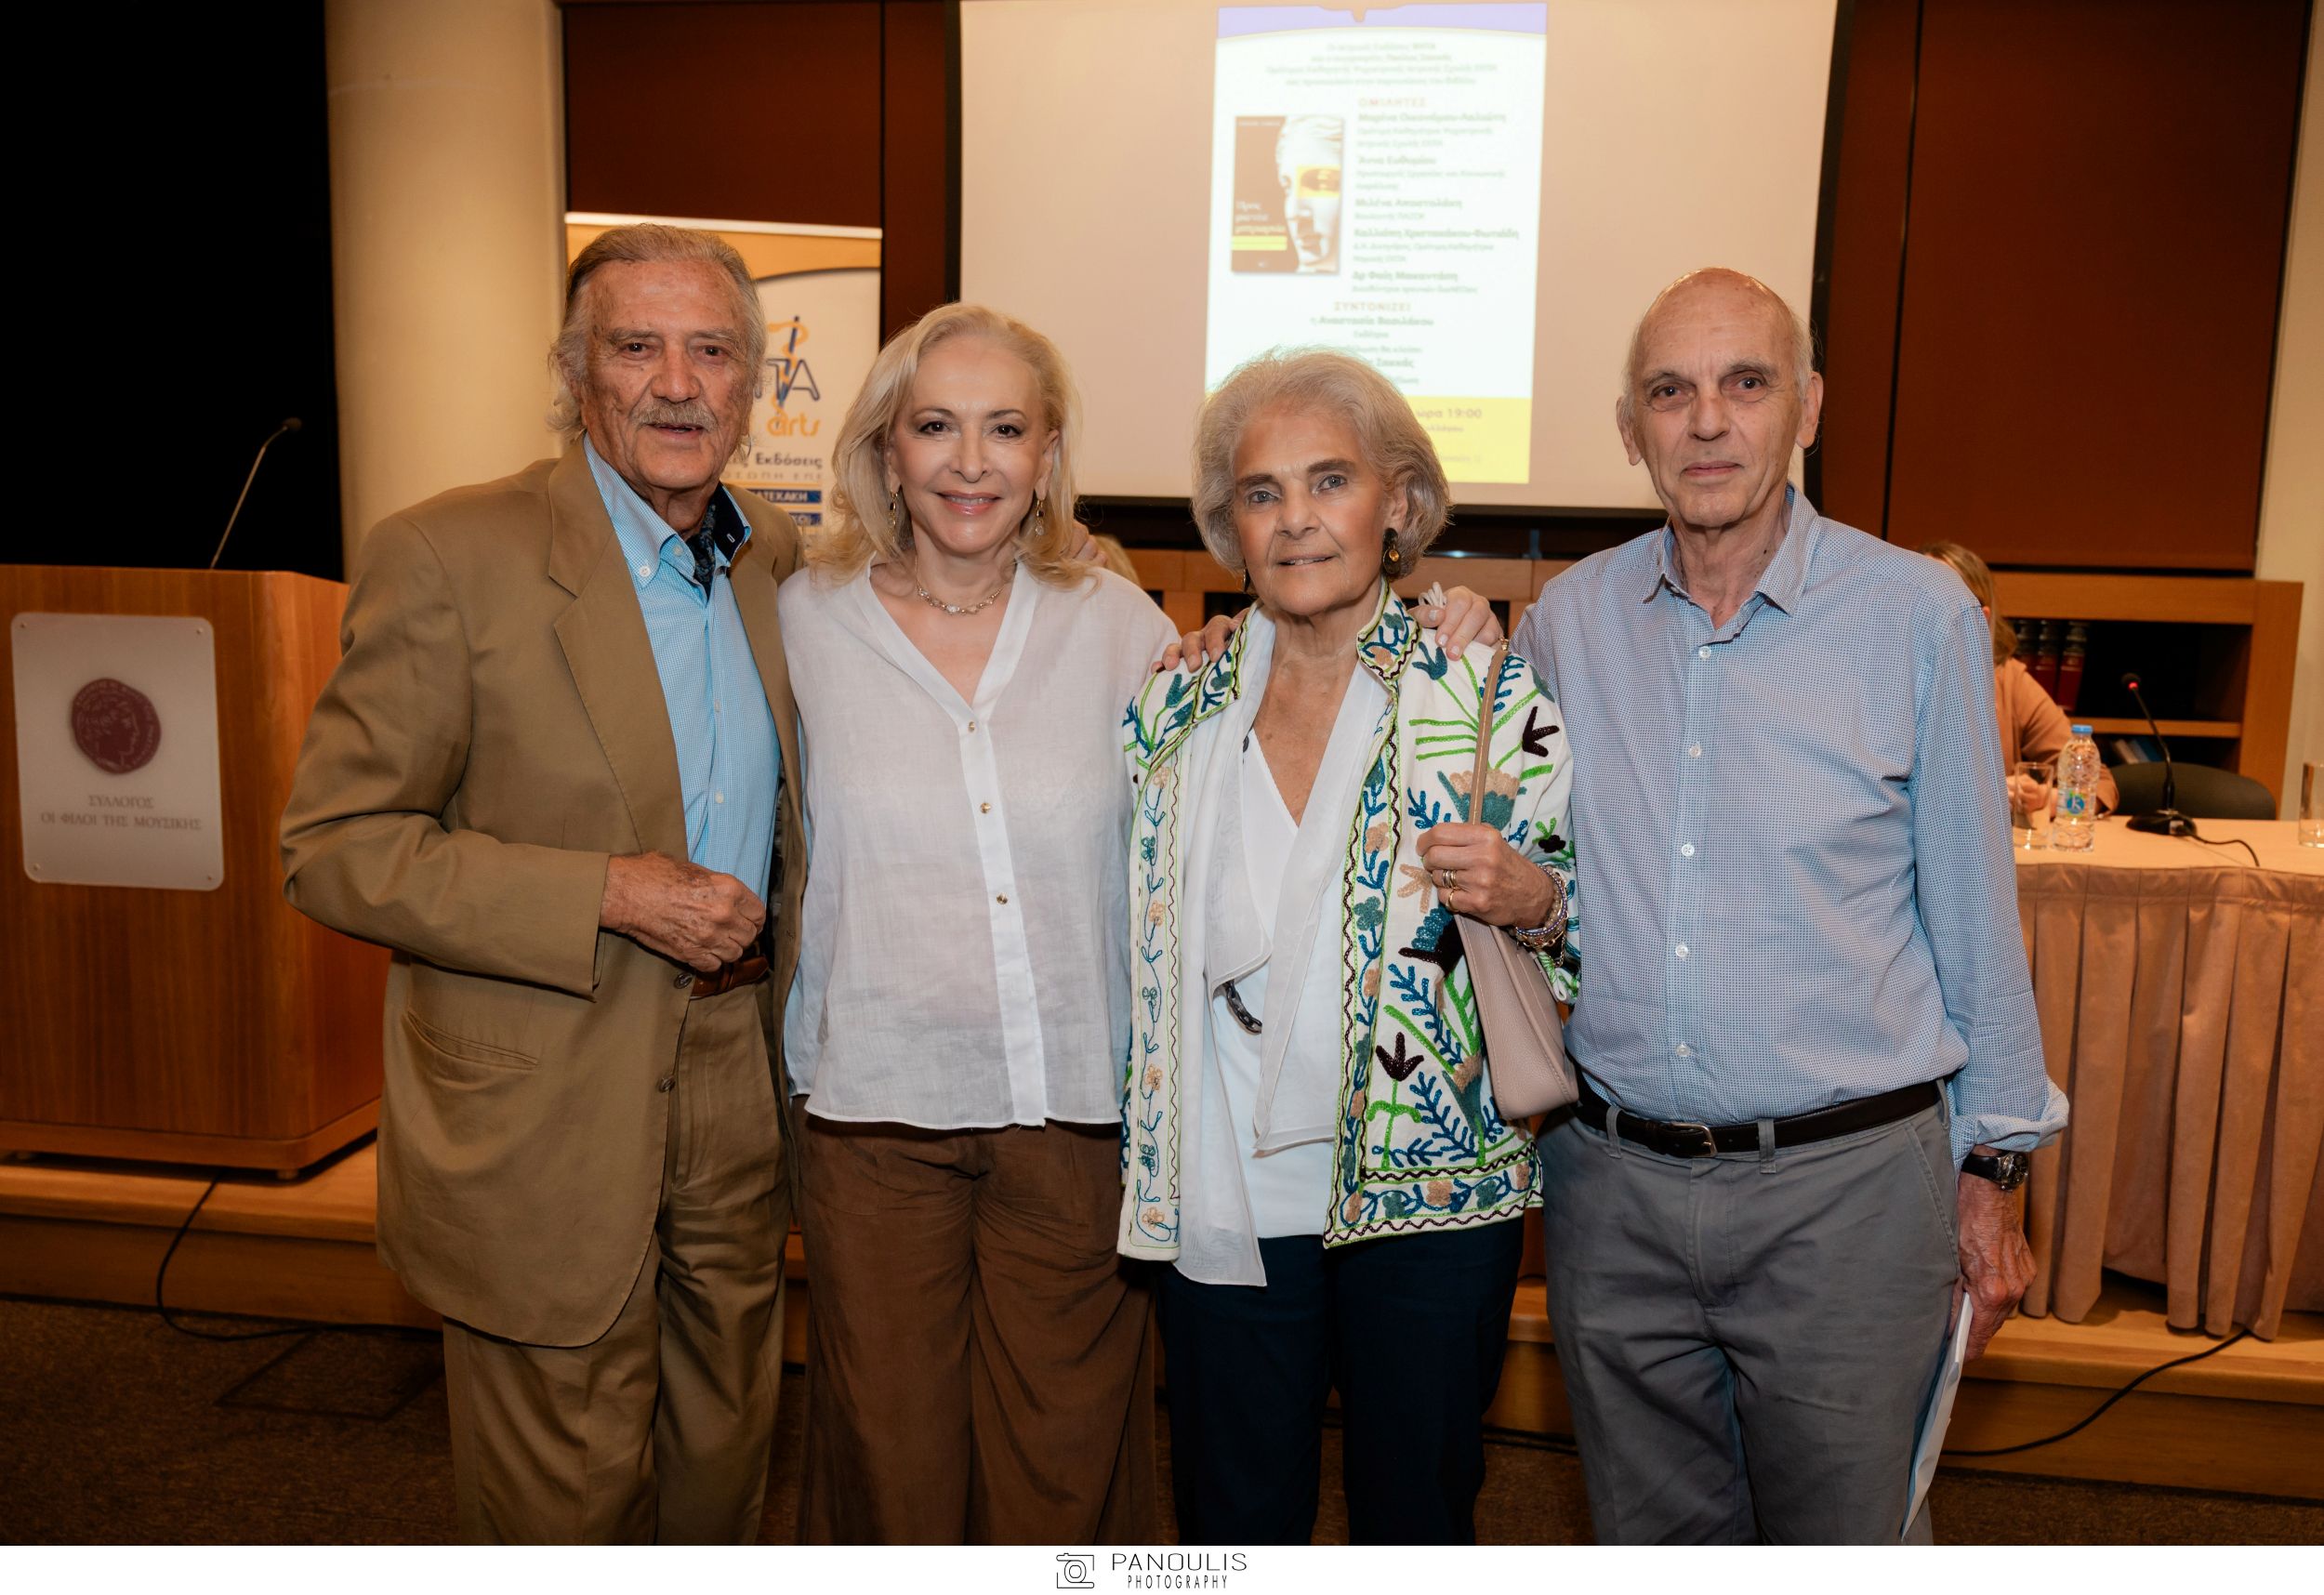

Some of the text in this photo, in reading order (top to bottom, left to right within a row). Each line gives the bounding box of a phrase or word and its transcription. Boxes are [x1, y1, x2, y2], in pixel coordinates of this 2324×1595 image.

[1447, 408, 1482, 418] 19:00
[756, 452, 822, 468] Εκδόσεις
[88, 795, 154, 809] ΣΥΛΛΟΓΟΣ
[41, 811, 202, 830] ΟΙ ΦΙΛΟΙ ΤΗΣ ΜΟΥΣΙΚΗΣ
